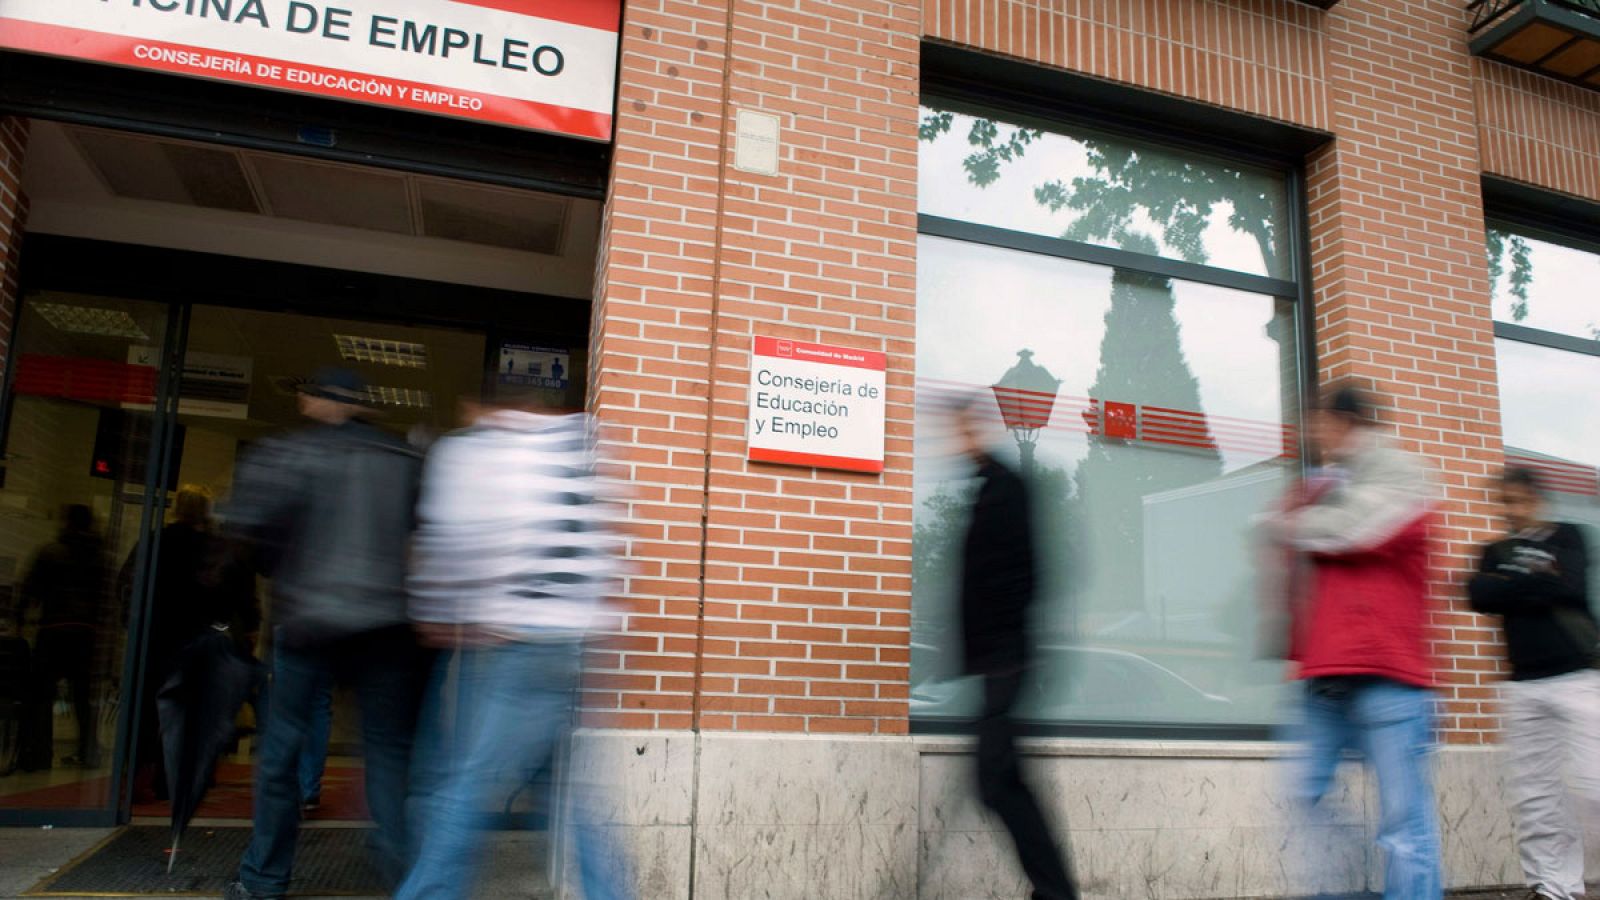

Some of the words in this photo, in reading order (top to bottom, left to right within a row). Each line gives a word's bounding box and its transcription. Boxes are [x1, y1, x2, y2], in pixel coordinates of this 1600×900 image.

[286, 1, 353, 41] DE
[369, 15, 565, 77] EMPLEO
[134, 45, 252, 75] CONSEJERÍA
[256, 64, 282, 80] DE
[286, 68, 392, 97] EDUCACIÓN
[396, 85, 408, 99] Y
[411, 88, 483, 111] EMPLEO
[857, 383, 879, 399] de
[756, 392, 848, 417] Educación
[755, 418, 766, 435] y
[771, 416, 839, 439] Empleo
